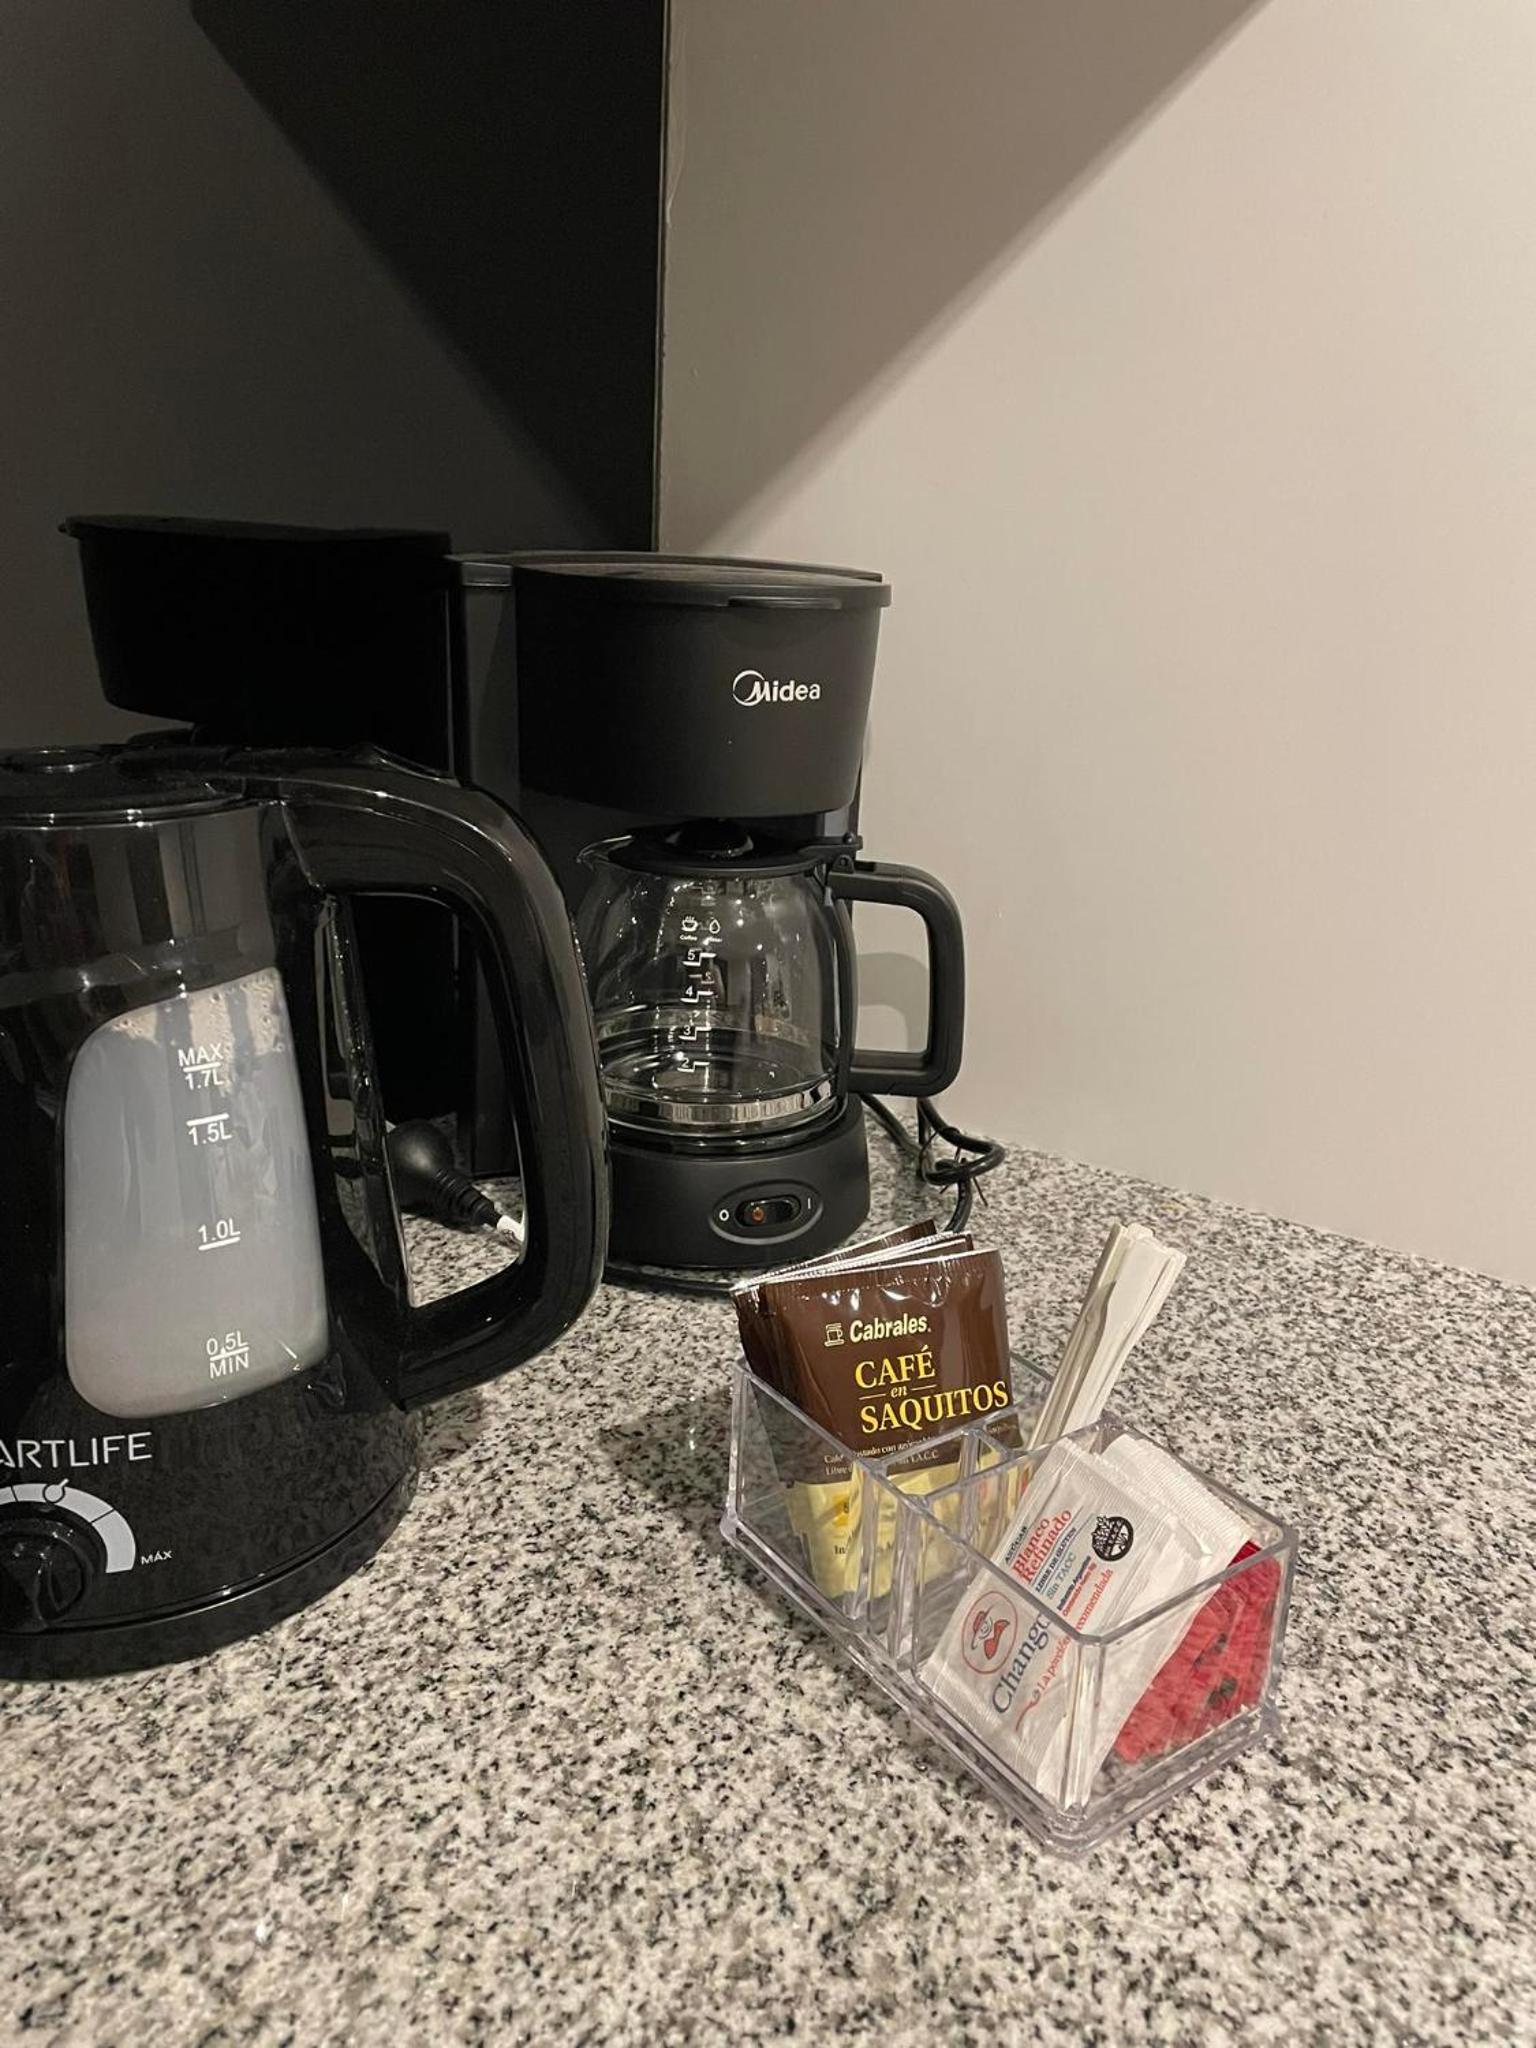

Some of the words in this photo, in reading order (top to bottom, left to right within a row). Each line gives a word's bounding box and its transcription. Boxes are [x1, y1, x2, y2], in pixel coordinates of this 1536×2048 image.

[733, 670, 821, 707] Midea
[685, 985, 694, 997] 4
[178, 1043, 224, 1068] MAX
[185, 1069, 224, 1091] 1.7L
[188, 1121, 232, 1147] 1.5L
[199, 1216, 241, 1243] 1.0L
[850, 1313, 928, 1343] Cabrales
[206, 1330, 248, 1356] 0.5L
[209, 1355, 250, 1380] MIN
[855, 1344, 936, 1389] CAFÉ
[890, 1385, 908, 1399] en
[860, 1381, 1009, 1434] SAQUITOS
[141, 1551, 172, 1565] MAX
[1012, 1518, 1050, 1576] Blanco
[1021, 1510, 1072, 1583] Refinado
